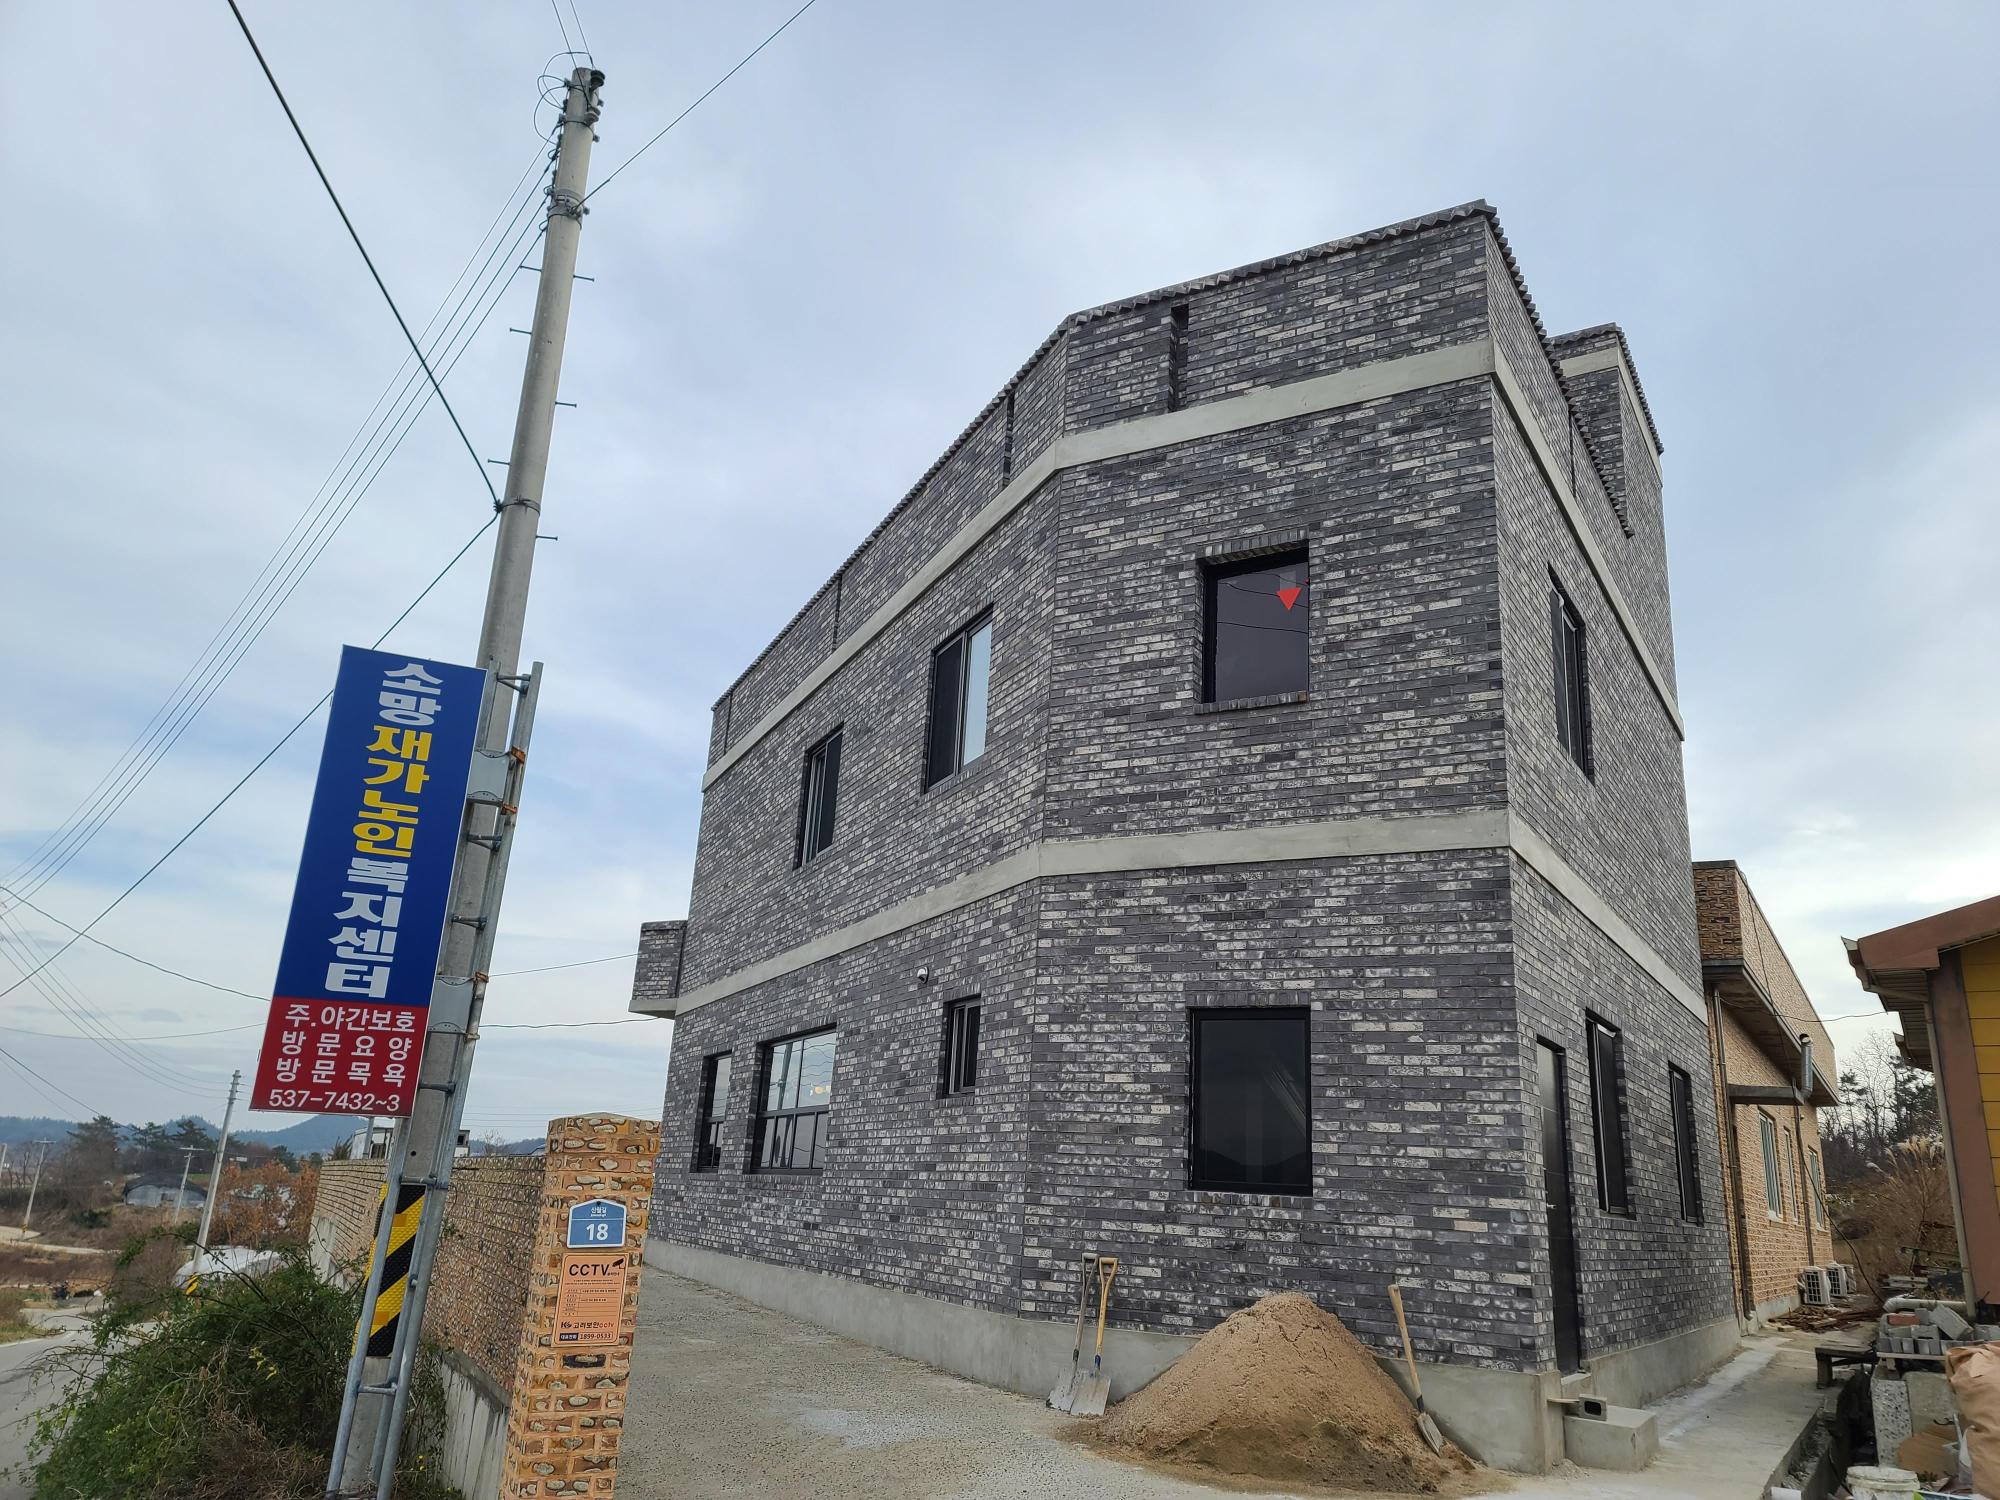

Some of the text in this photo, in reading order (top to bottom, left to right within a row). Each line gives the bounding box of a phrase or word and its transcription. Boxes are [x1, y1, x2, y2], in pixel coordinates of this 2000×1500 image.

[285, 1003, 415, 1033] 주.야간보호
[269, 1089, 400, 1112] 537-7432~3
[586, 1223, 609, 1241] 18
[569, 1263, 610, 1277] CCTV
